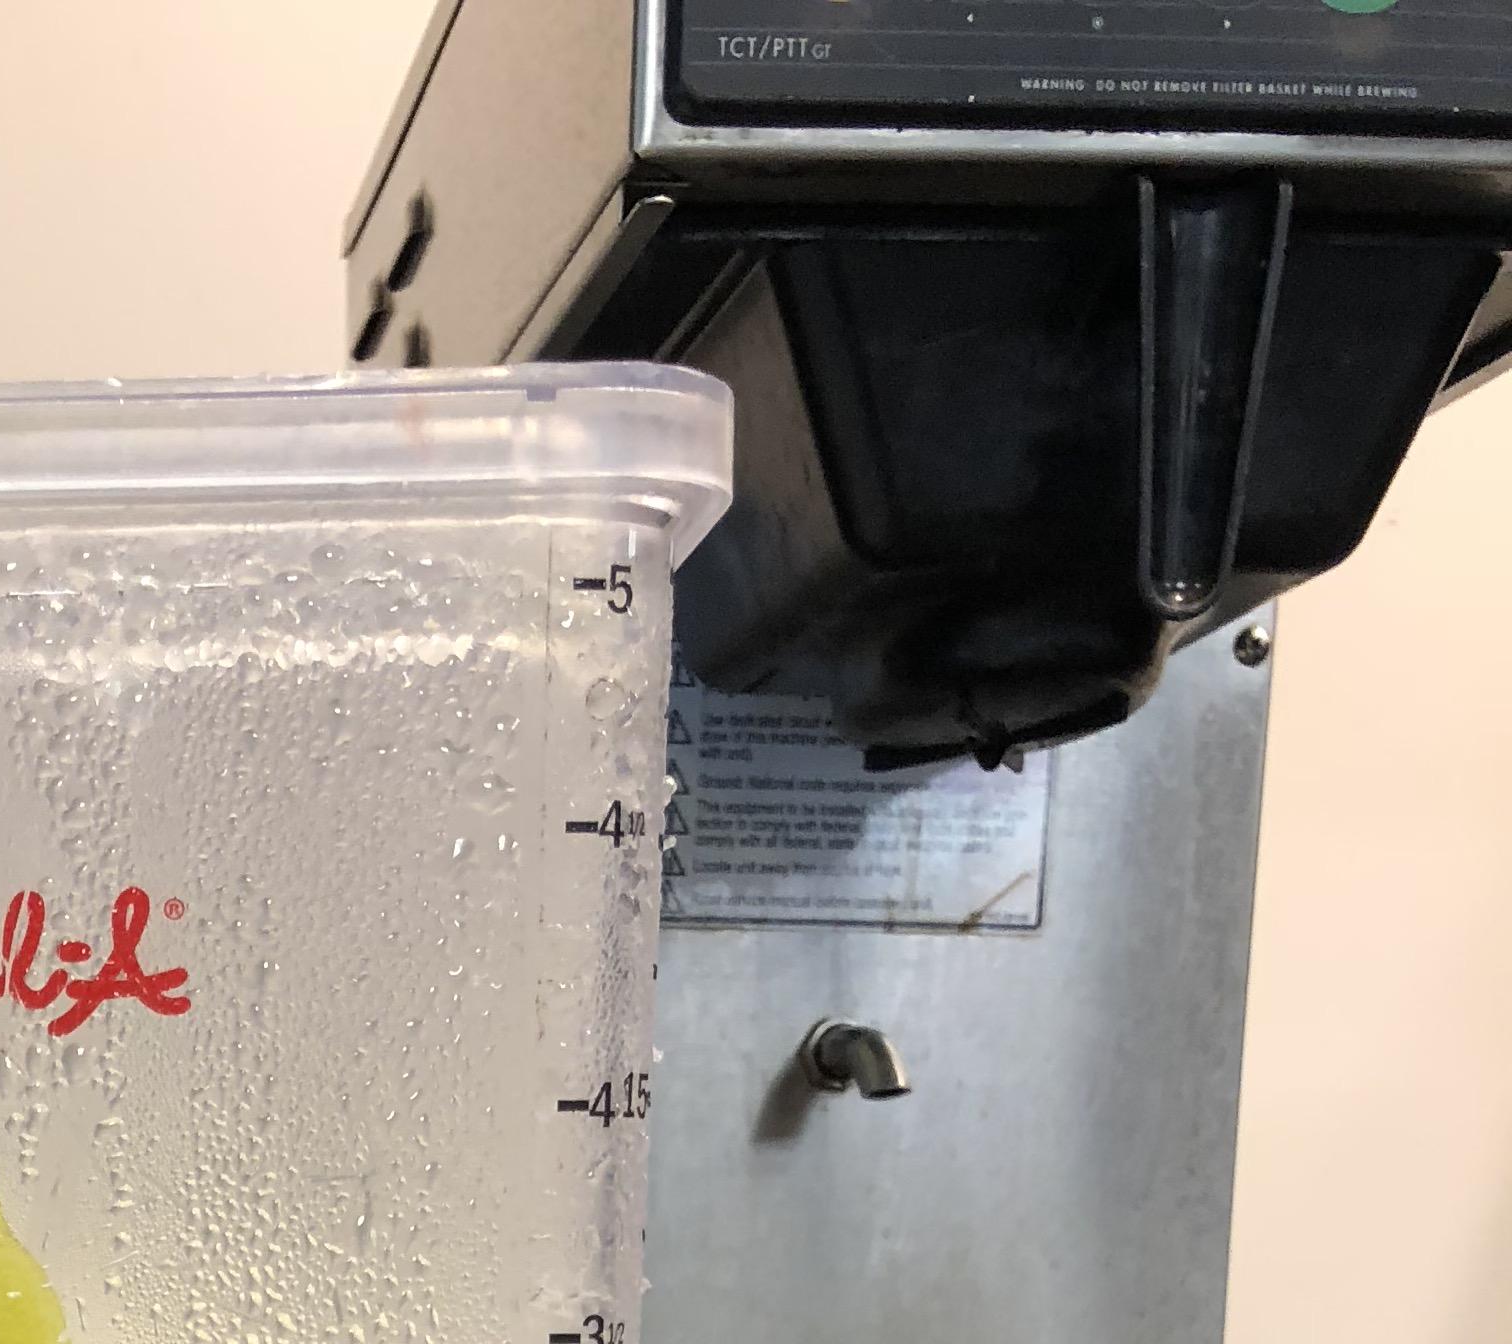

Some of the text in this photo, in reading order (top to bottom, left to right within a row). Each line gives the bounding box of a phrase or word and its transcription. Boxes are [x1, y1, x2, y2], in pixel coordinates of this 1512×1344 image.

[1095, 79, 1115, 92] DO
[1121, 79, 1149, 92] NOT
[1154, 80, 1208, 94] REMOVE
[1212, 81, 1253, 94] FILTER
[1258, 82, 1307, 96] BASKET
[1312, 84, 1352, 97] WHILE
[1357, 85, 1419, 98] BREWING
[607, 563, 634, 615] 5
[588, 1081, 616, 1128] 4
